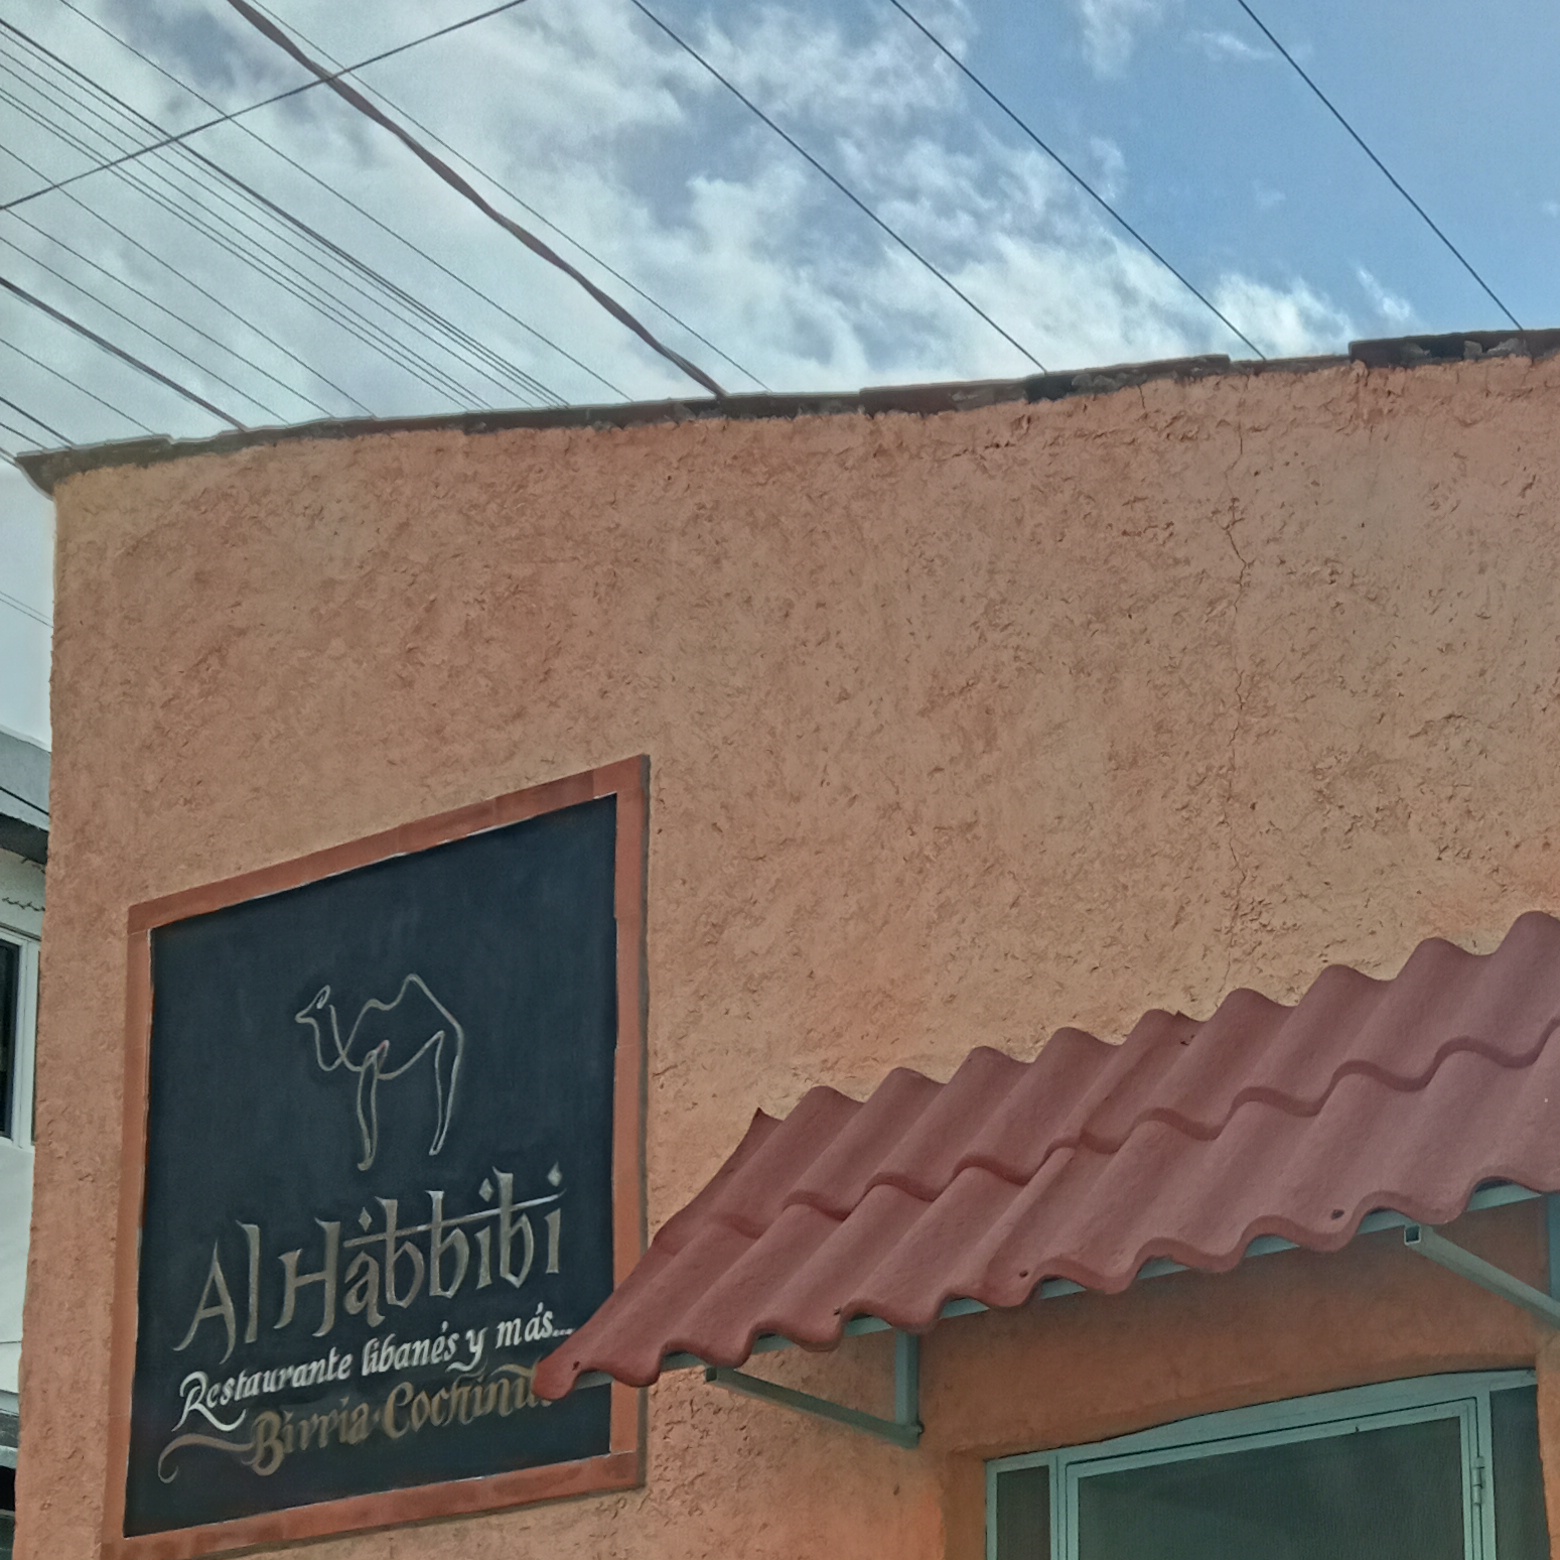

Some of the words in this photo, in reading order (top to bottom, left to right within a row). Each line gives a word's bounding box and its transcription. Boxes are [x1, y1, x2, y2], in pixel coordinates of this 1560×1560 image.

[172, 1218, 261, 1365] Al
[272, 1161, 567, 1338] Habbibi
[171, 1346, 354, 1432] Restaurante
[361, 1320, 460, 1377] libanés
[445, 1326, 489, 1373] y
[180, 1397, 371, 1482] Birria
[382, 1355, 554, 1440] Cochini
